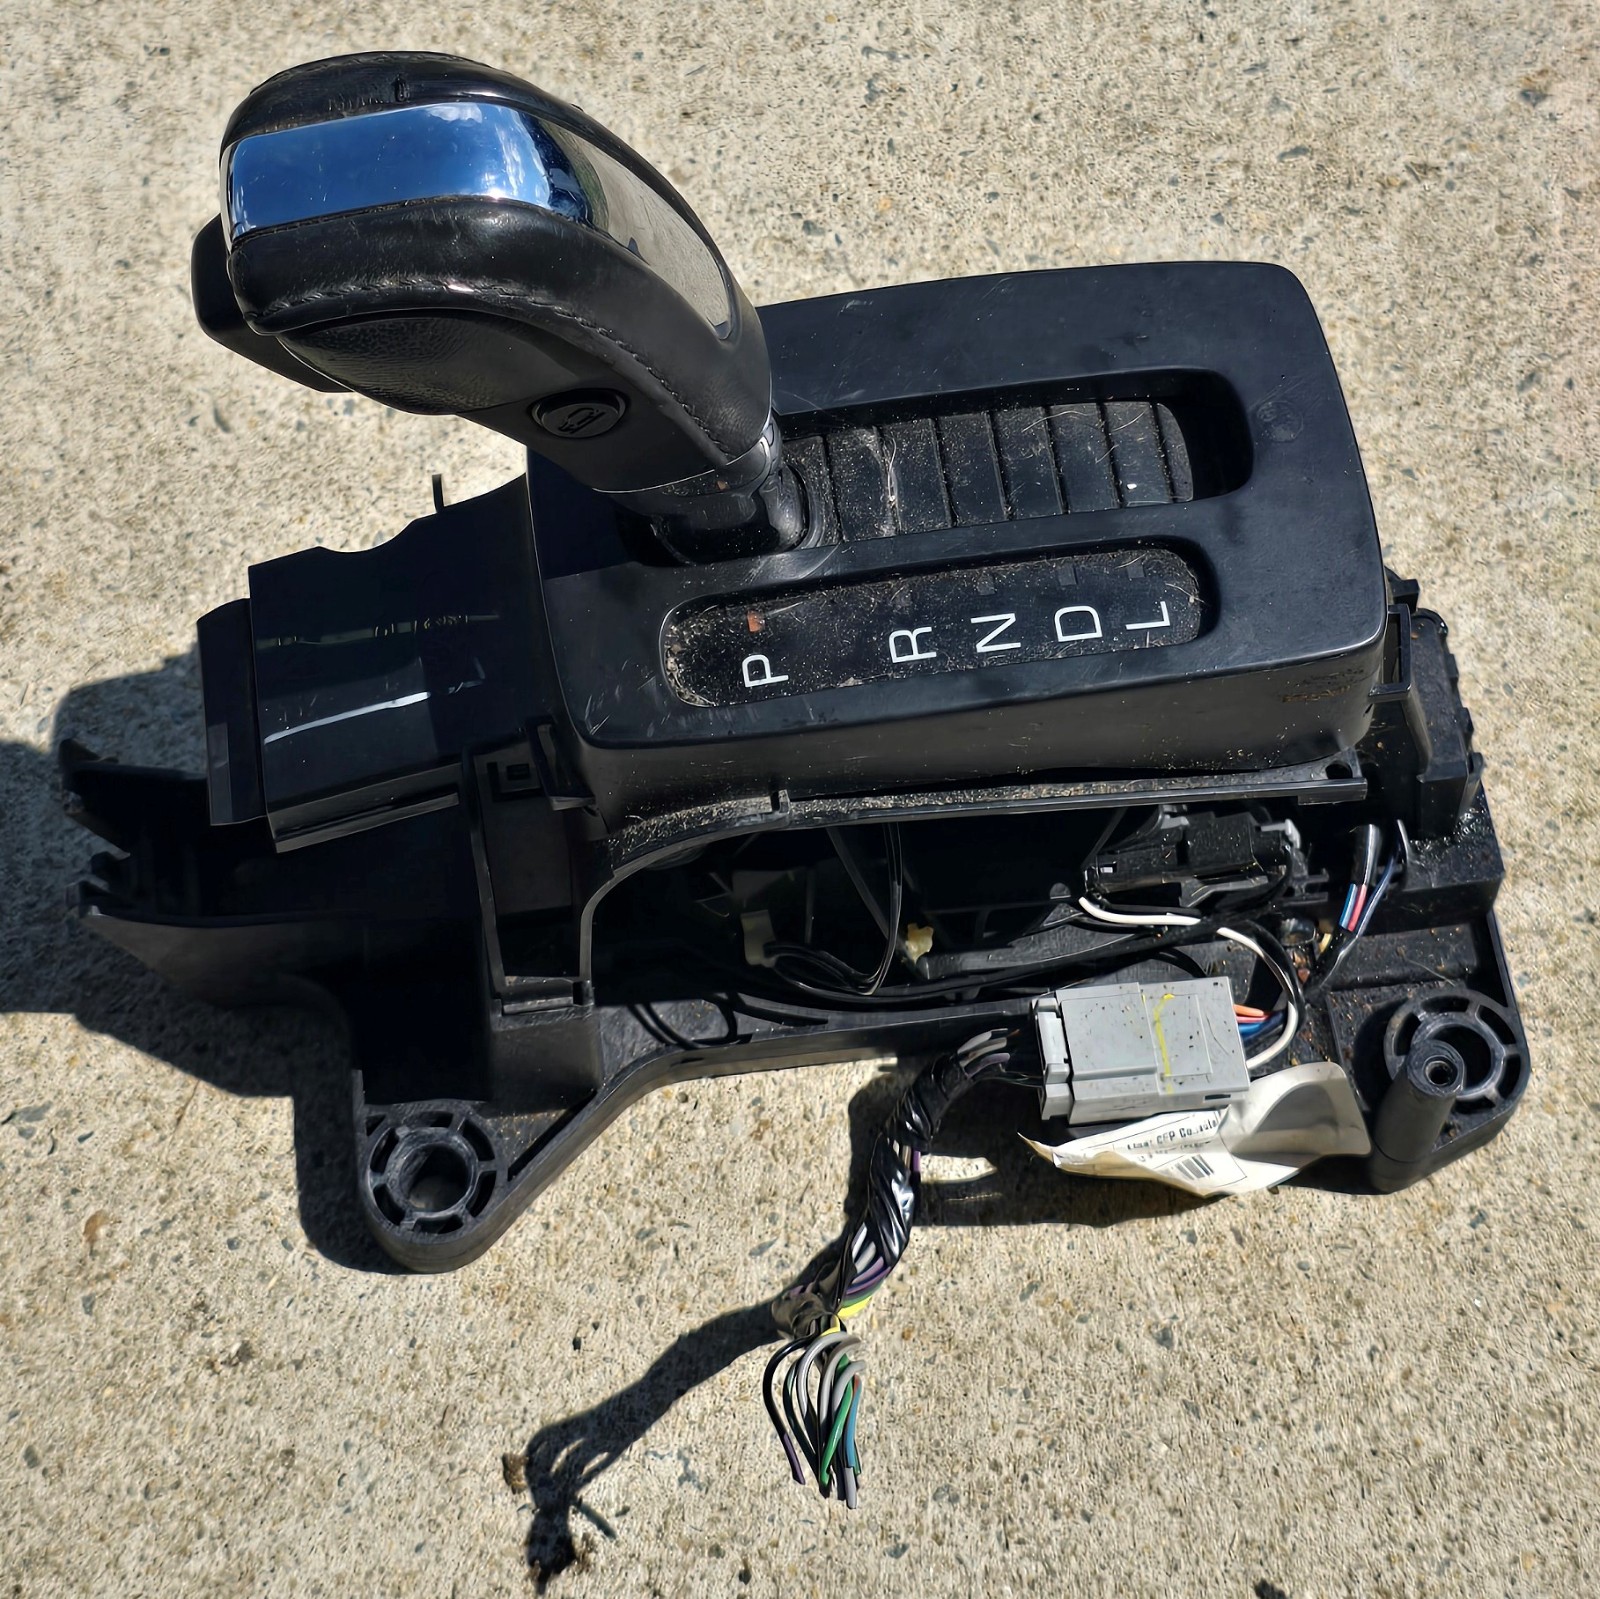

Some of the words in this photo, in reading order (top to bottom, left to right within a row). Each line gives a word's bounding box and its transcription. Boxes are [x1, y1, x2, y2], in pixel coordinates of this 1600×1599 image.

[741, 654, 789, 688] P
[888, 626, 937, 664] R
[970, 612, 1022, 653] N
[1054, 605, 1103, 643] D
[1125, 600, 1171, 630] L
